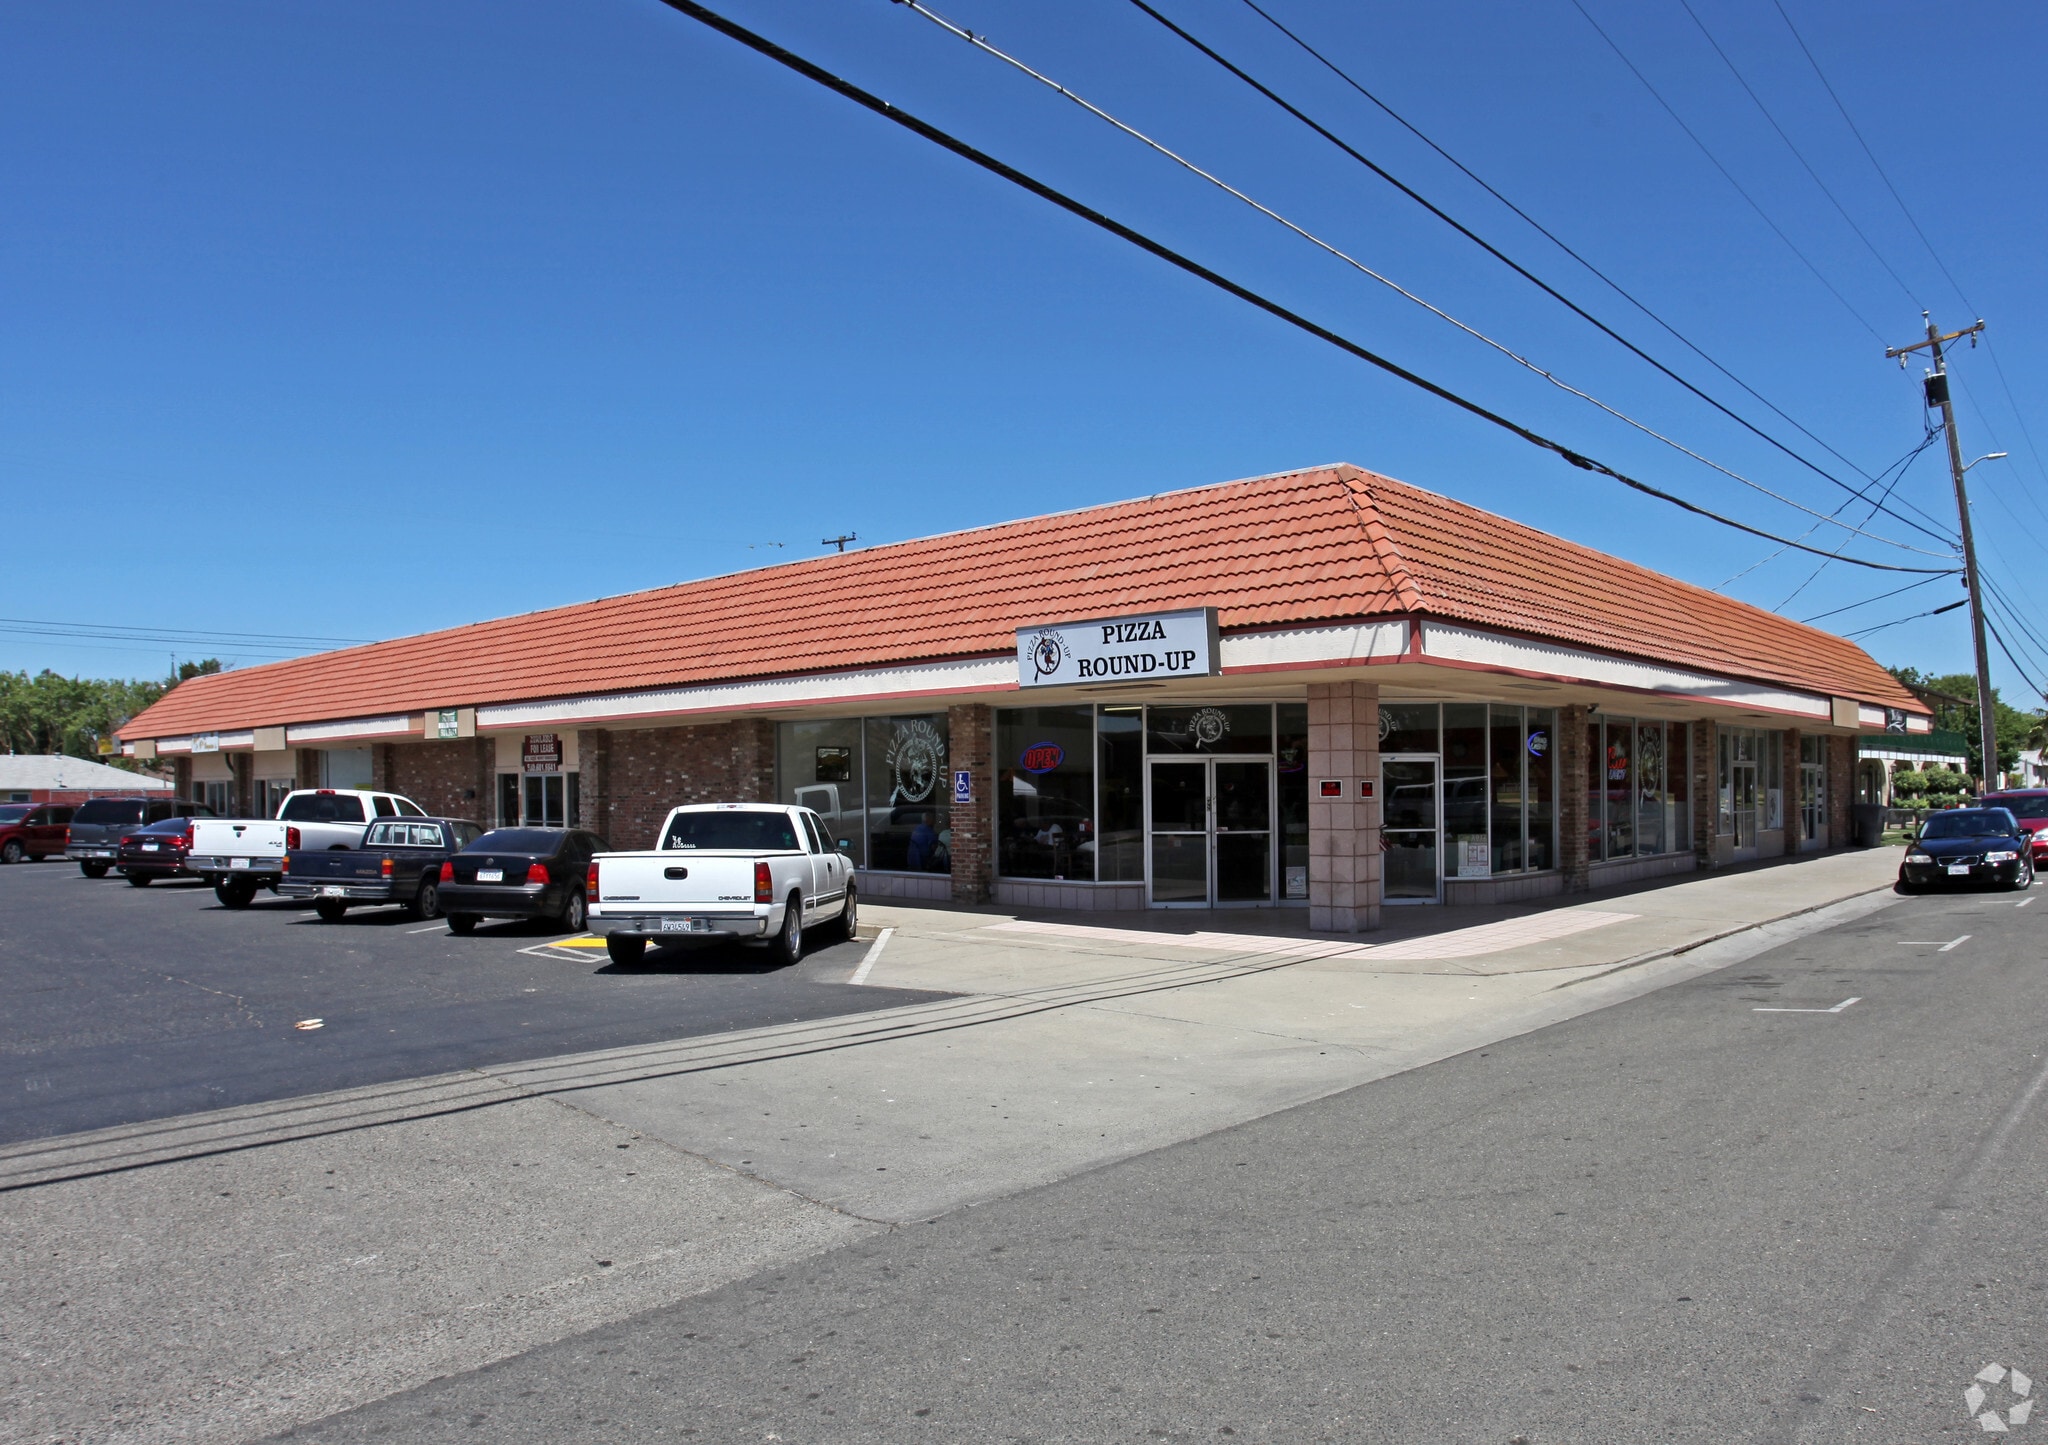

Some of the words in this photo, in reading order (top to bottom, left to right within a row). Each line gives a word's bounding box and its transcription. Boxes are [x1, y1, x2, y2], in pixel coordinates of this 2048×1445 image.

[1027, 635, 1039, 661] PIZZA
[1039, 628, 1072, 659] ROUND-UP
[1101, 620, 1167, 645] PIZZA
[1077, 650, 1197, 677] ROUND-UP
[1189, 712, 1202, 732] PIZZA
[1201, 707, 1231, 732] ROUND-UP
[530, 745, 540, 753] FOR
[540, 744, 554, 753] LEASE
[885, 724, 909, 765] PIZZA
[910, 719, 948, 788] ROUND-UP
[1024, 747, 1059, 769] OPEN
